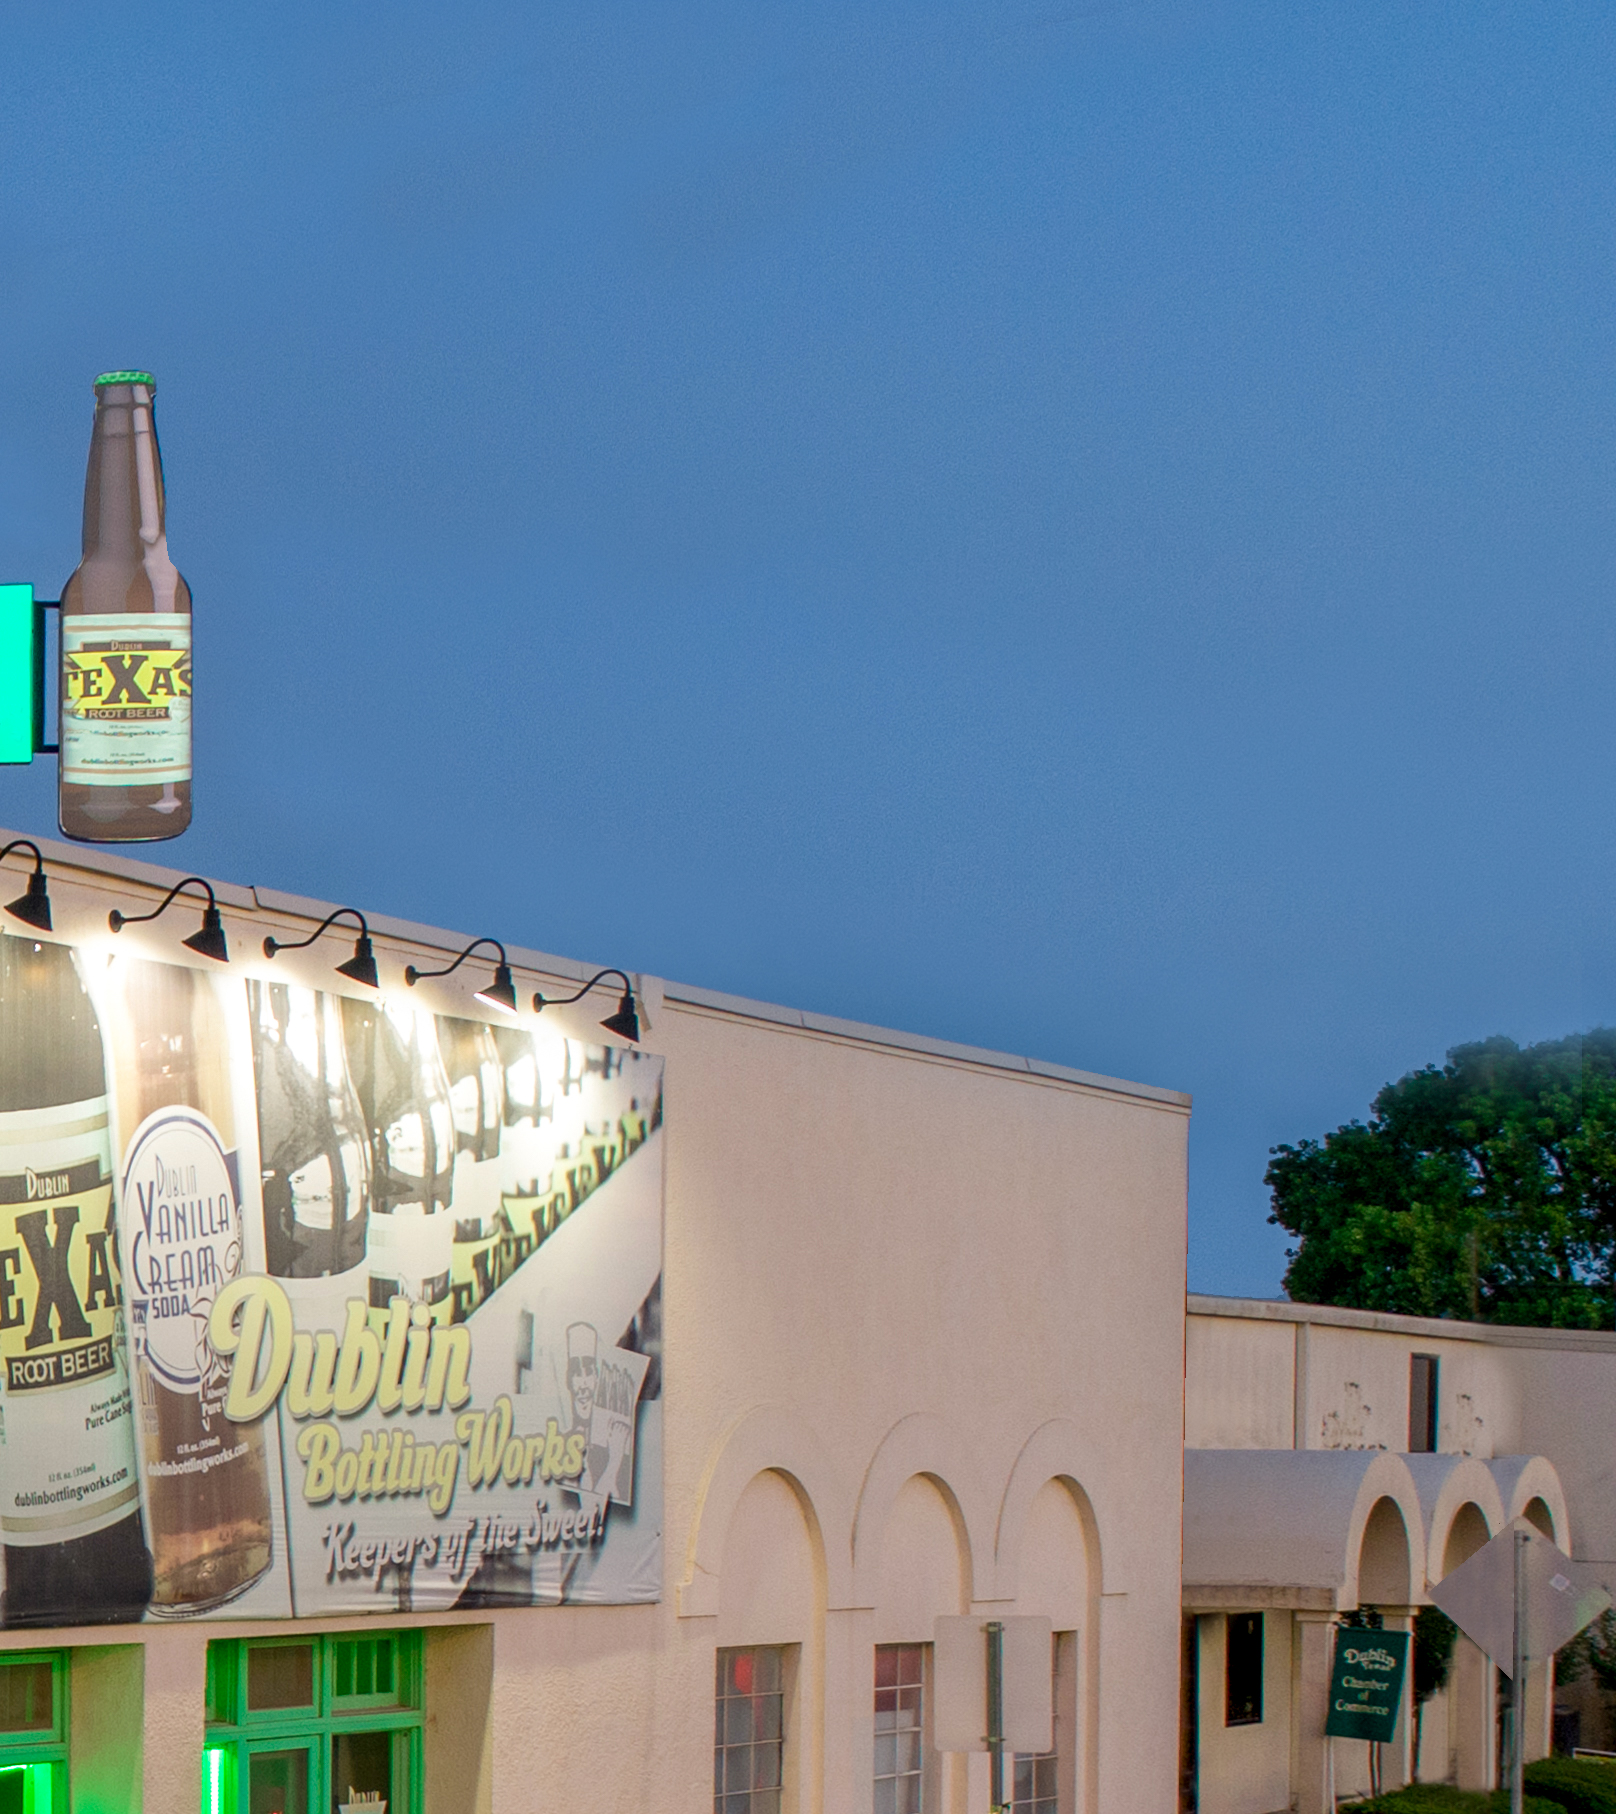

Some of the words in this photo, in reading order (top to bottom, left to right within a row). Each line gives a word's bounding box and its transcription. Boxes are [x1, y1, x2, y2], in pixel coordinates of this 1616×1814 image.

[89, 708, 124, 718] ROOT
[126, 708, 166, 718] BEER
[26, 1167, 69, 1199] DUBLIN
[155, 1153, 198, 1198] DUBLIN
[136, 1181, 230, 1248] VANILLA
[132, 1245, 217, 1295] CREAM
[151, 1293, 191, 1319] SODA
[12, 1357, 57, 1385] ROOT
[61, 1342, 110, 1377] BEER
[209, 1272, 471, 1422] Dublin
[85, 1415, 104, 1430] Pure
[105, 1408, 121, 1424] Cane
[201, 1401, 221, 1417] Pure
[148, 1442, 249, 1476] dublinbottlingworks.com
[297, 1420, 458, 1515] Bottling
[455, 1394, 587, 1486] Works
[14, 1467, 128, 1508] dublinbottlingworks.com
[323, 1520, 437, 1584] Keepers
[479, 1508, 520, 1552] the
[525, 1499, 608, 1547] Sweet!
[1343, 1647, 1396, 1669] Dublin
[1342, 1675, 1390, 1691] Chamber
[1335, 1699, 1390, 1716] Commerce
